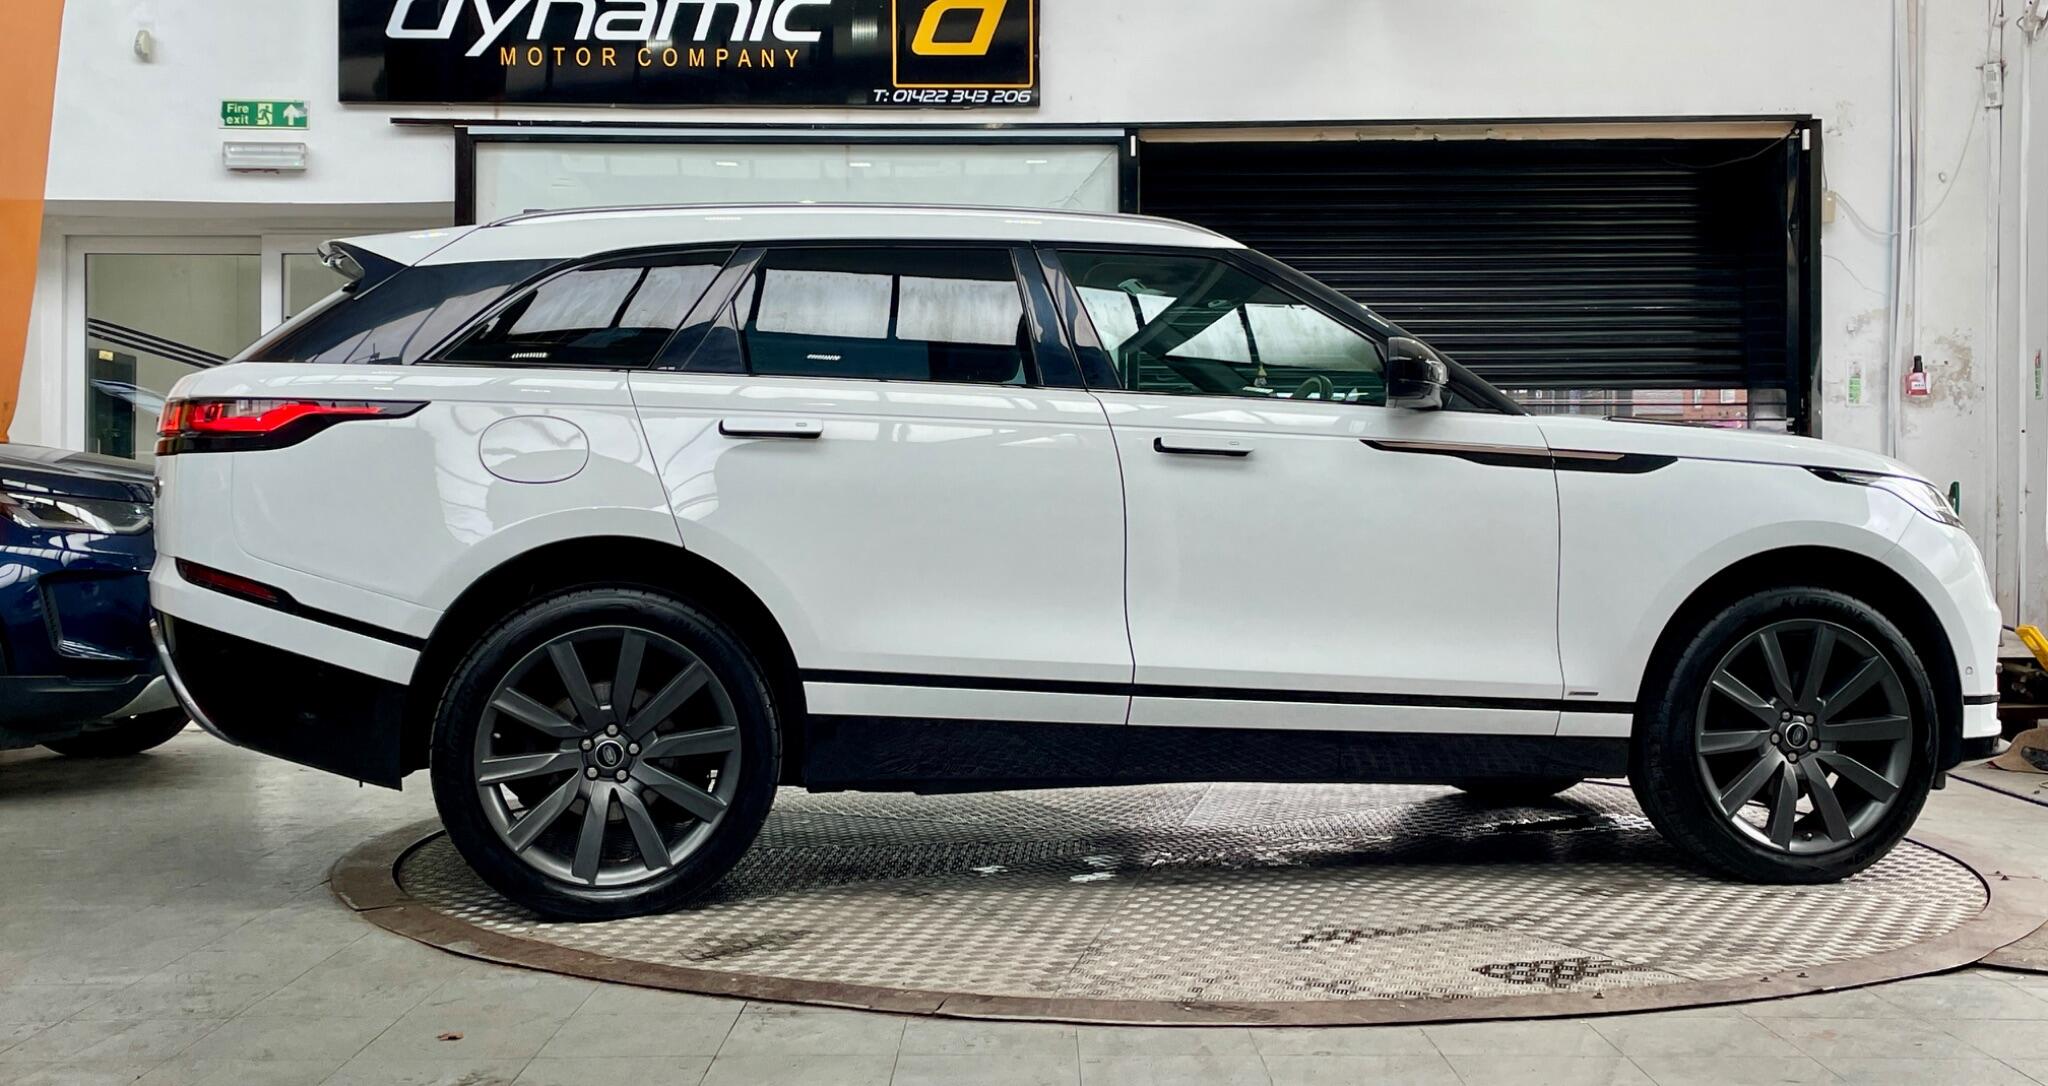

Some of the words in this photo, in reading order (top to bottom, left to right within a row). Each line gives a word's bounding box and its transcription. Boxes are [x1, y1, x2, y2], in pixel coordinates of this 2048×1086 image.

[501, 47, 616, 66] MOTOR
[637, 48, 798, 68] COMPANY
[873, 89, 890, 102] T:
[893, 90, 949, 103] 01422
[951, 90, 988, 103] 343
[991, 90, 1031, 103] 206
[227, 103, 249, 113] Fire
[226, 115, 249, 125] exit
